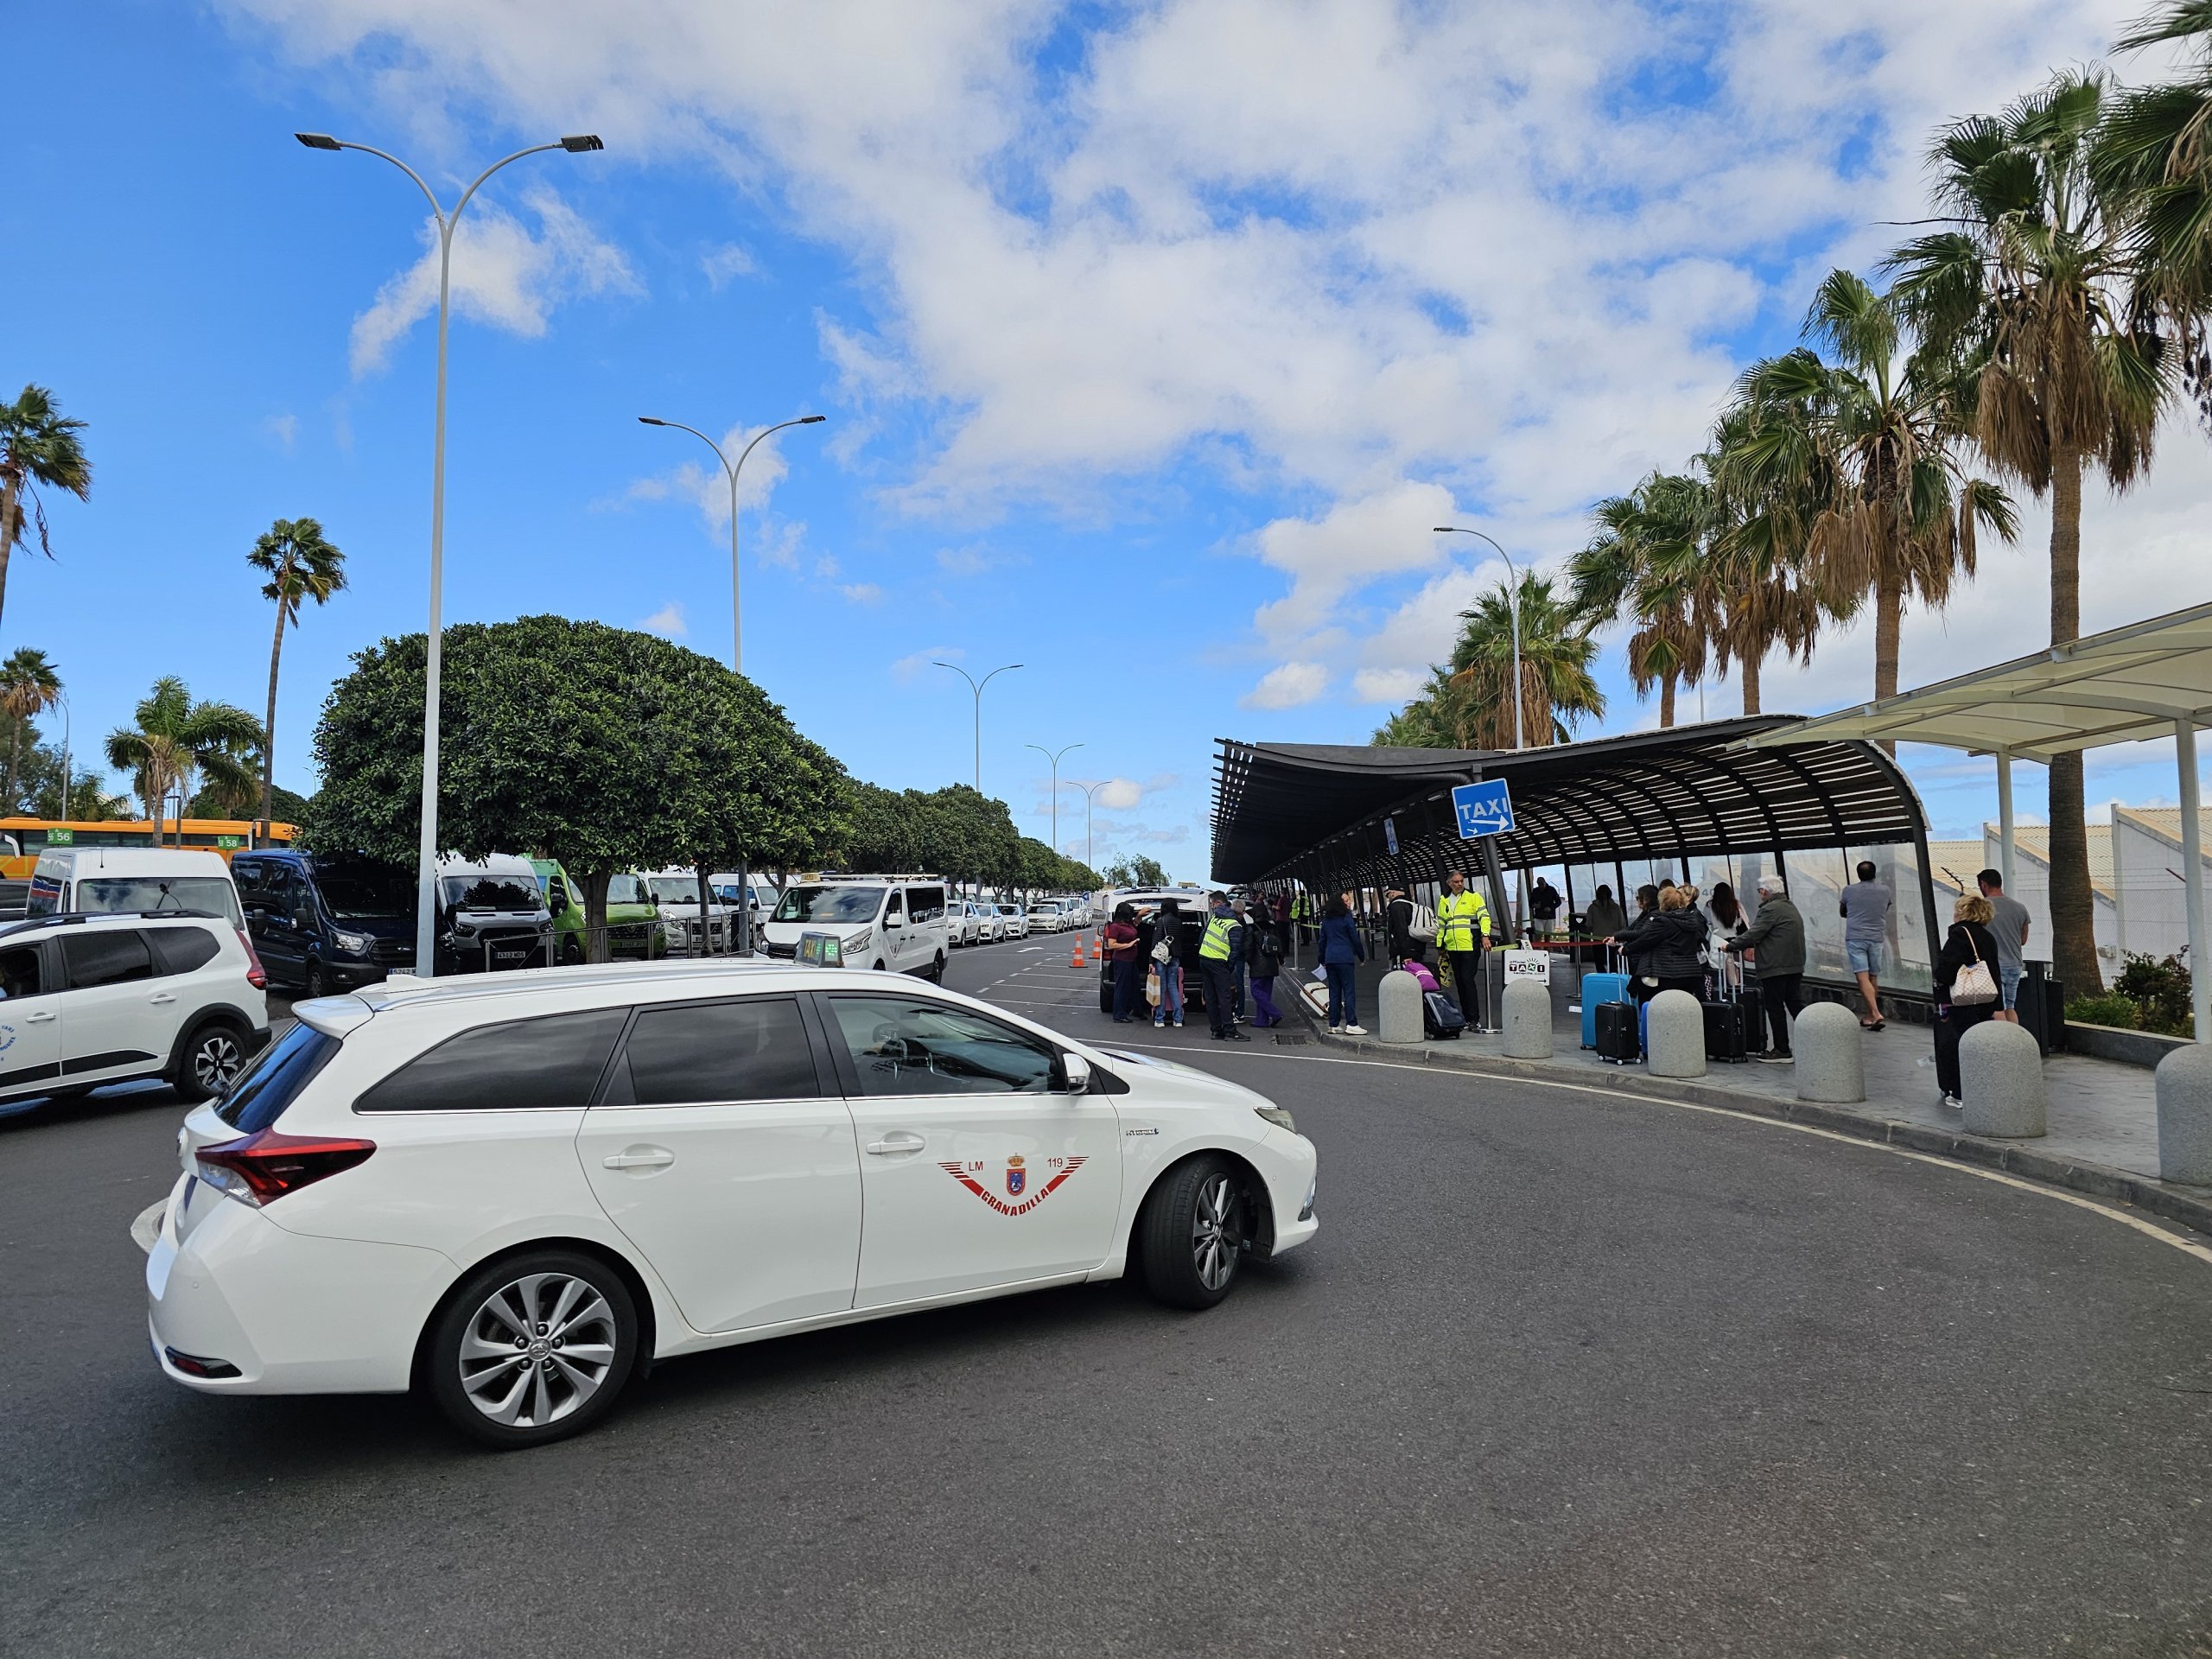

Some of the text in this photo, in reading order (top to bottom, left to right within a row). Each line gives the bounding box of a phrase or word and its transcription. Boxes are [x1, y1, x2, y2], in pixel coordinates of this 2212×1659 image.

[1459, 798, 1508, 820] TAXI
[57, 832, 71, 842] 56
[226, 839, 238, 848] 58
[803, 938, 817, 958] TAXI
[1509, 963, 1545, 973] TAXI
[968, 1161, 983, 1172] LM
[1046, 1158, 1063, 1167] 119
[981, 1187, 1049, 1217] GRANADILLA
